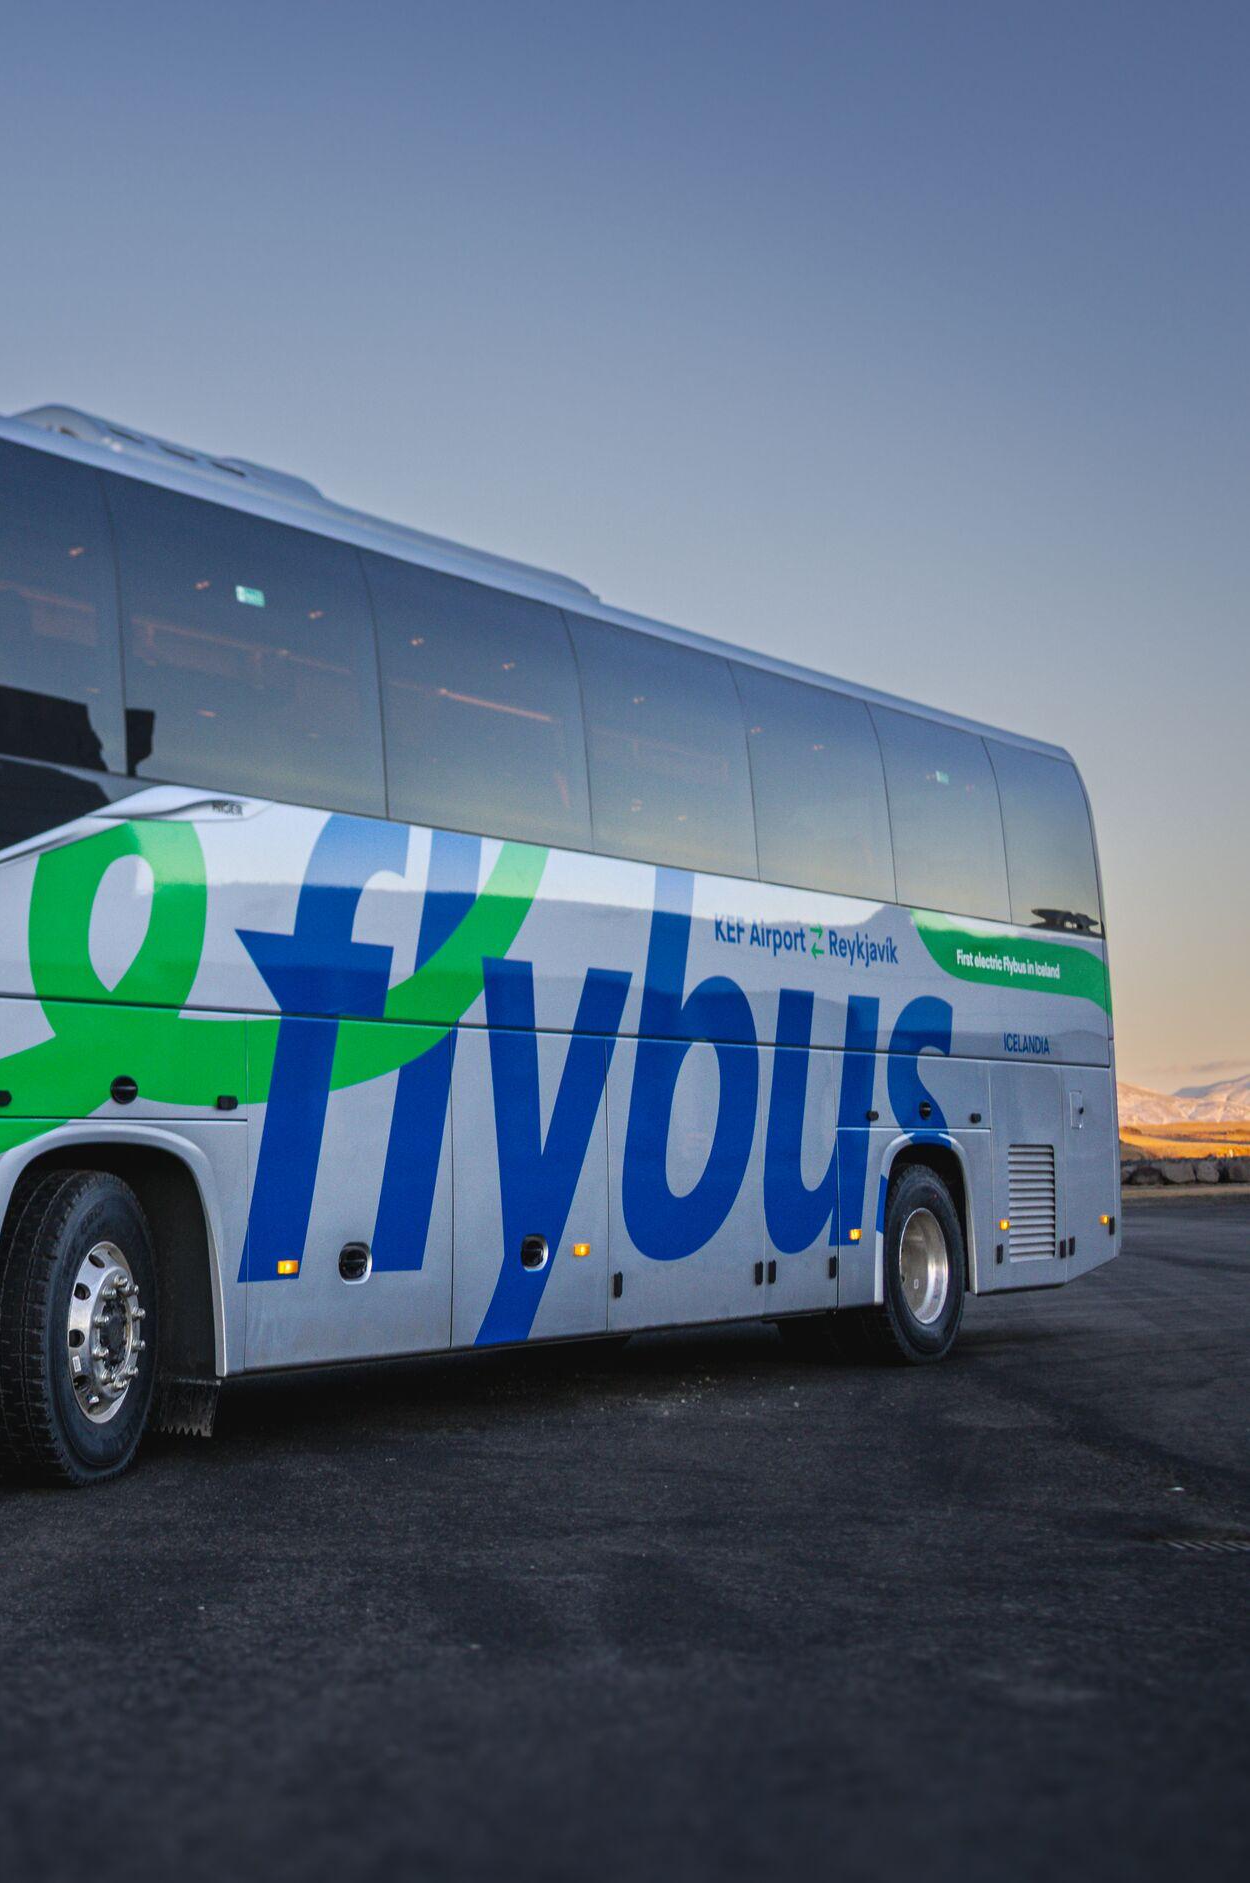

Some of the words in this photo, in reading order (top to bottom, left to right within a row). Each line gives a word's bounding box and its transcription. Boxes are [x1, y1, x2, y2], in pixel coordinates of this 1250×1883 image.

[714, 914, 745, 944] KEF
[750, 920, 807, 957] Airport
[828, 929, 899, 968] Reykjavík
[956, 948, 974, 967] First
[974, 952, 1002, 971] electric
[1003, 955, 1027, 976] Flybus
[1027, 958, 1035, 975] in
[1035, 961, 1060, 979] Iceland
[1003, 1031, 1051, 1055] ICELANDIA
[234, 812, 954, 1346] flybus
